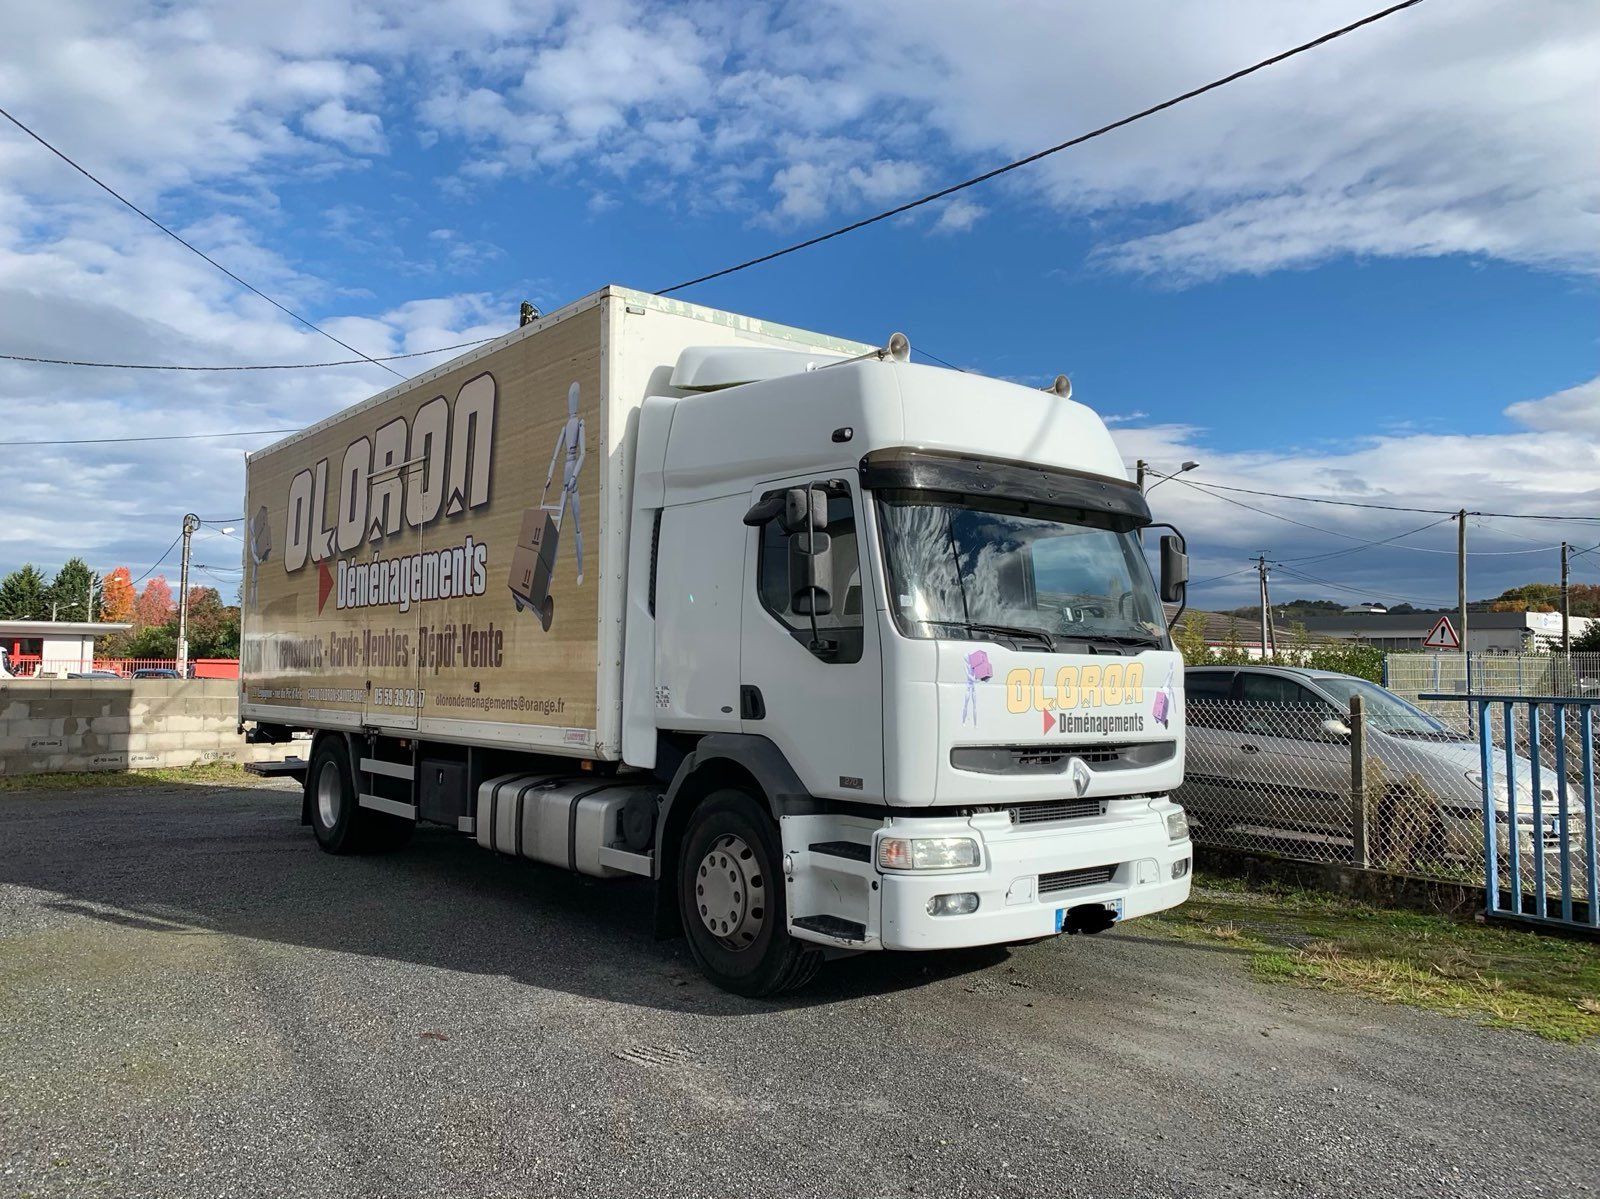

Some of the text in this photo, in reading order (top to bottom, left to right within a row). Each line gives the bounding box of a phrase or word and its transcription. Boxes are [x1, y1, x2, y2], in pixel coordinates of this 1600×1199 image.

[285, 371, 497, 573] OLORON
[336, 535, 488, 613] Déménagements
[273, 622, 503, 675] ransports Garde-Meubles Dépôt-Vente
[435, 694, 565, 715] olorondemenagements@orange.fr
[1006, 662, 1144, 714] OLORON
[1059, 712, 1144, 735] Déménagements
